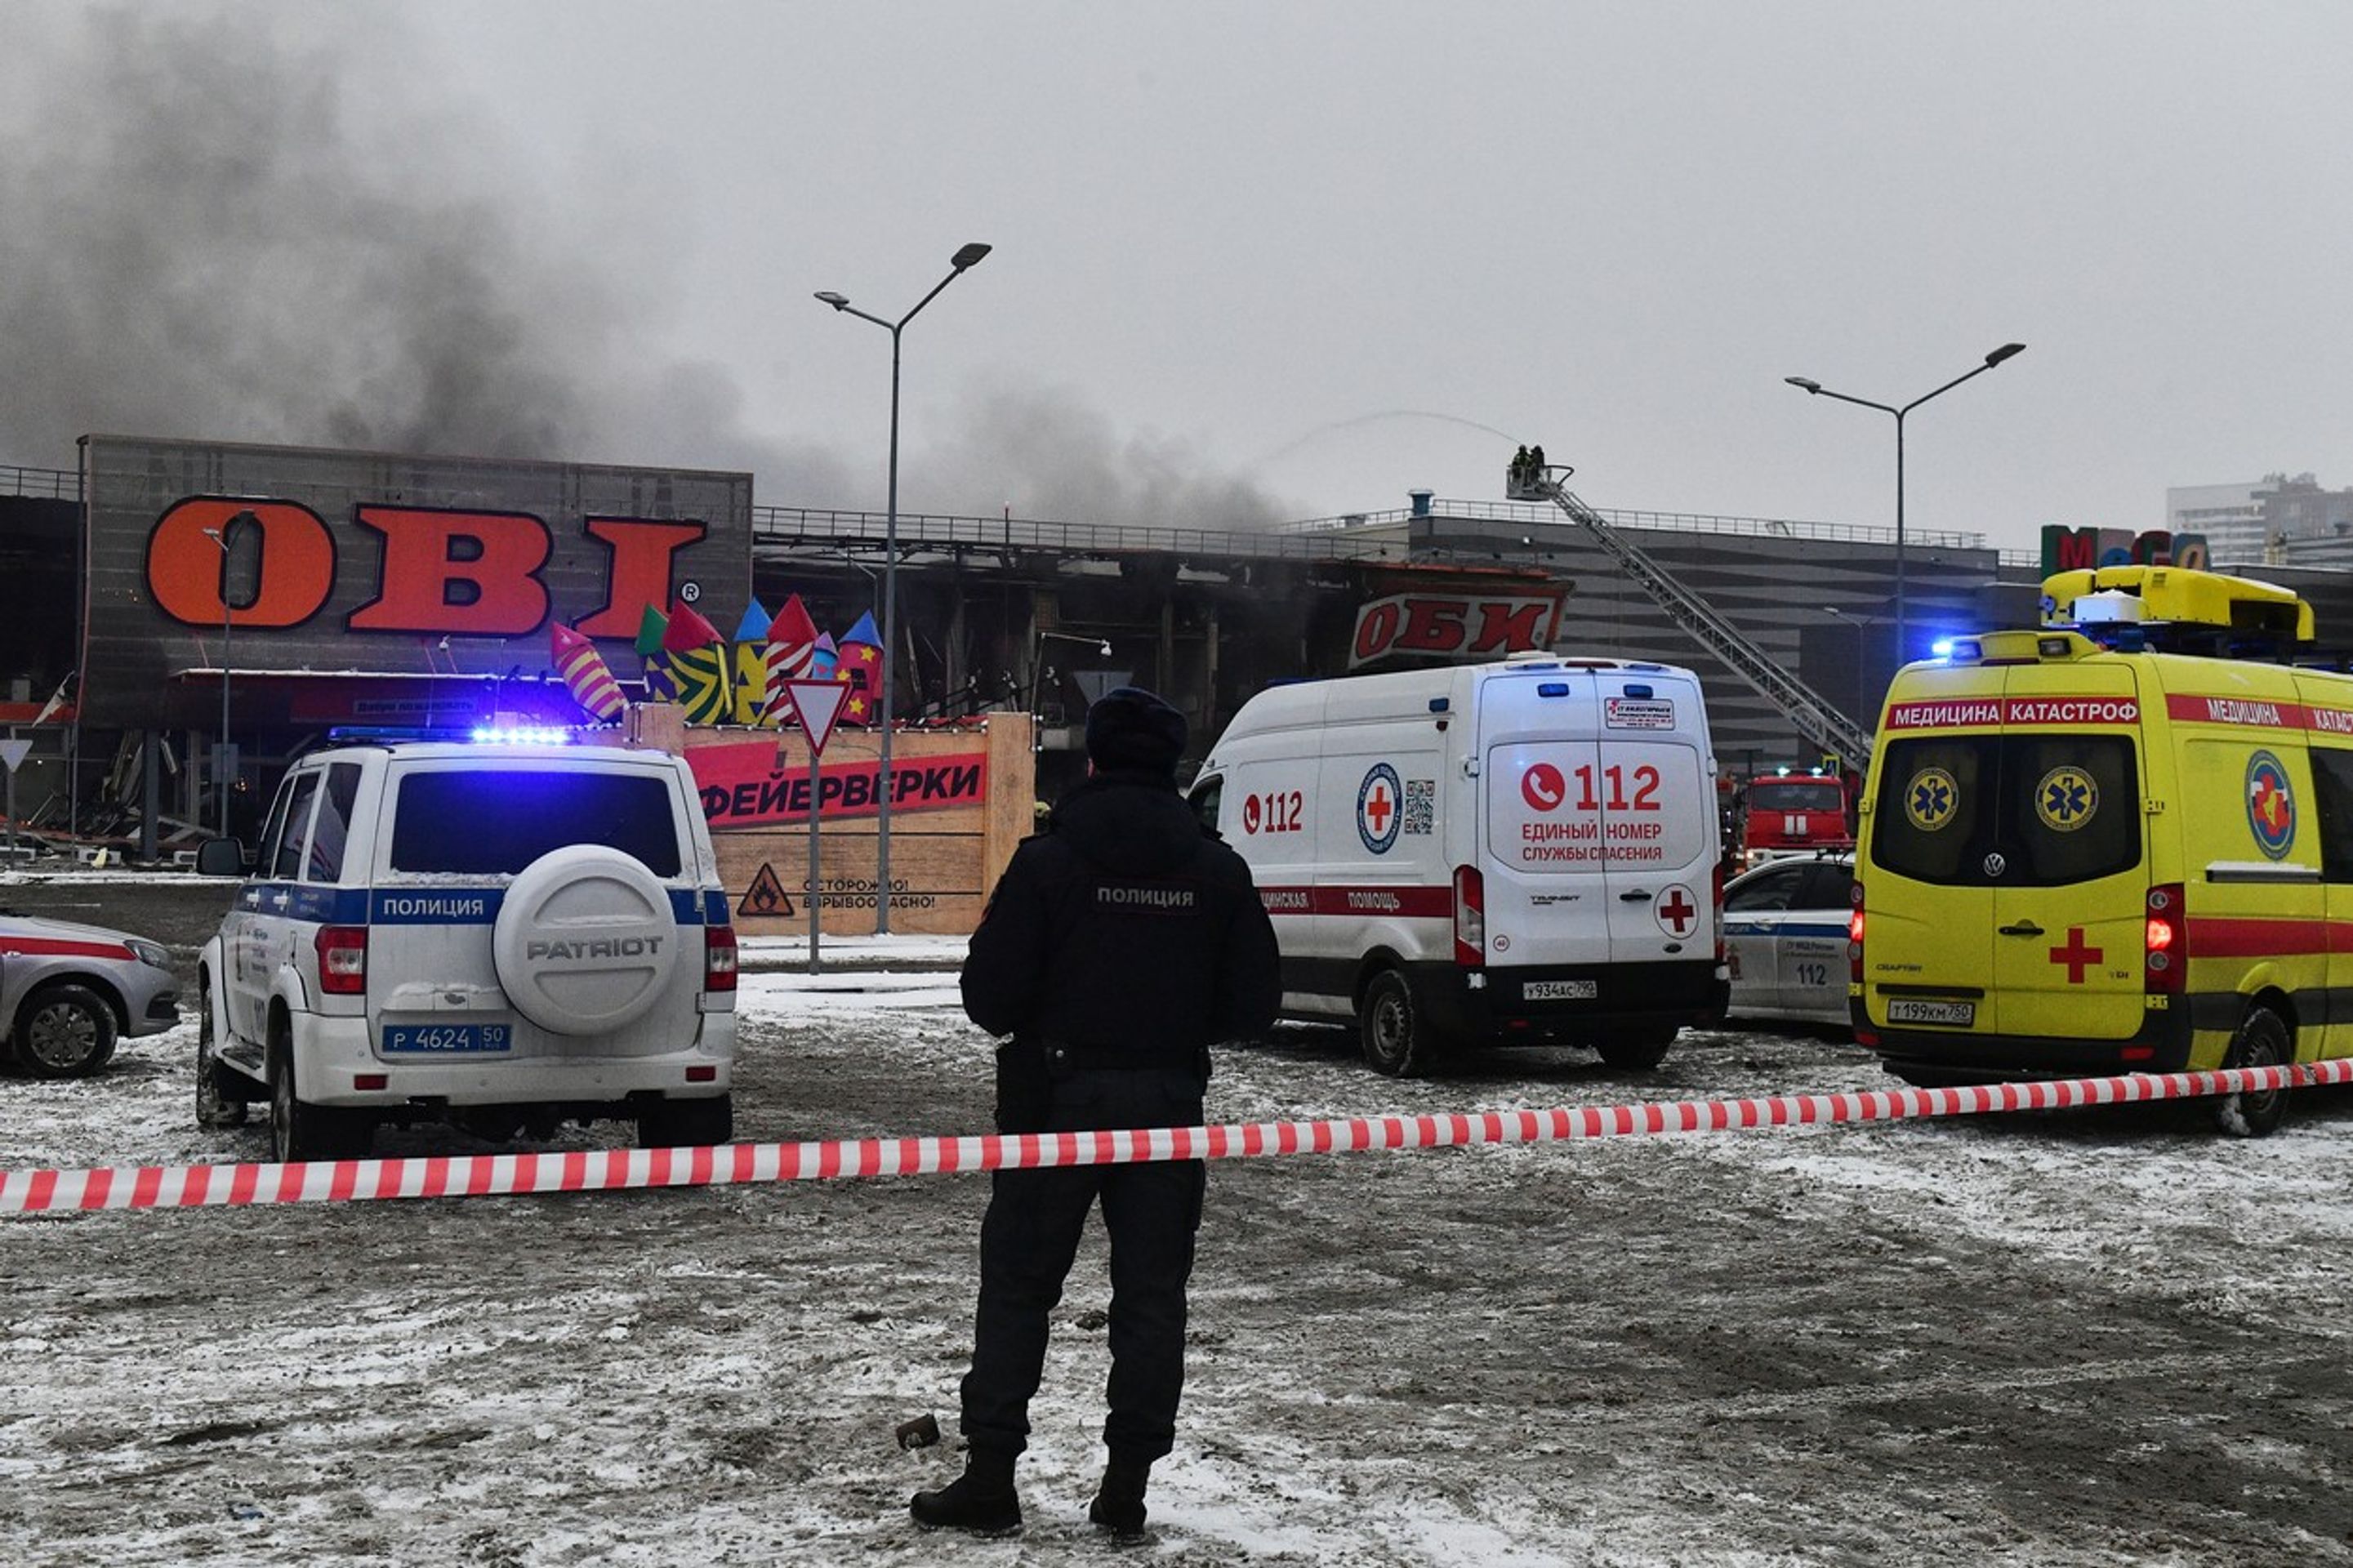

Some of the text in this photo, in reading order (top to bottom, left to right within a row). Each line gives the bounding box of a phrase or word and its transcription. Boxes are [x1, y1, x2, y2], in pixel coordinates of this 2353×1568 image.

[144, 495, 708, 639] OBI
[1356, 599, 1549, 659] ОБИ
[1896, 702, 2137, 726] МЕДИЦИНА КАТАСТРОФ
[2207, 698, 2282, 725] МЕДИЦИНА
[699, 764, 981, 820] ФЕЙЕРВЕРКИ
[1575, 764, 1660, 811] 112
[1265, 791, 1302, 833] 112
[1522, 818, 1661, 842] ЕДИНЫЙ НОМЕР
[1522, 846, 1662, 862] СЛУЖБЫ СПАСЕНИЯ
[384, 898, 484, 917] ПОЛИЦИЯ
[803, 896, 935, 908] ВРЫВООАСНО!
[1098, 887, 1192, 908] ПОЛИЦИЯ
[1348, 892, 1400, 912] ПОМОЩЬ
[527, 935, 663, 960] PATRIOT
[1797, 963, 1825, 985] 112
[416, 1027, 469, 1049] 4624
[483, 1027, 504, 1042] 50
